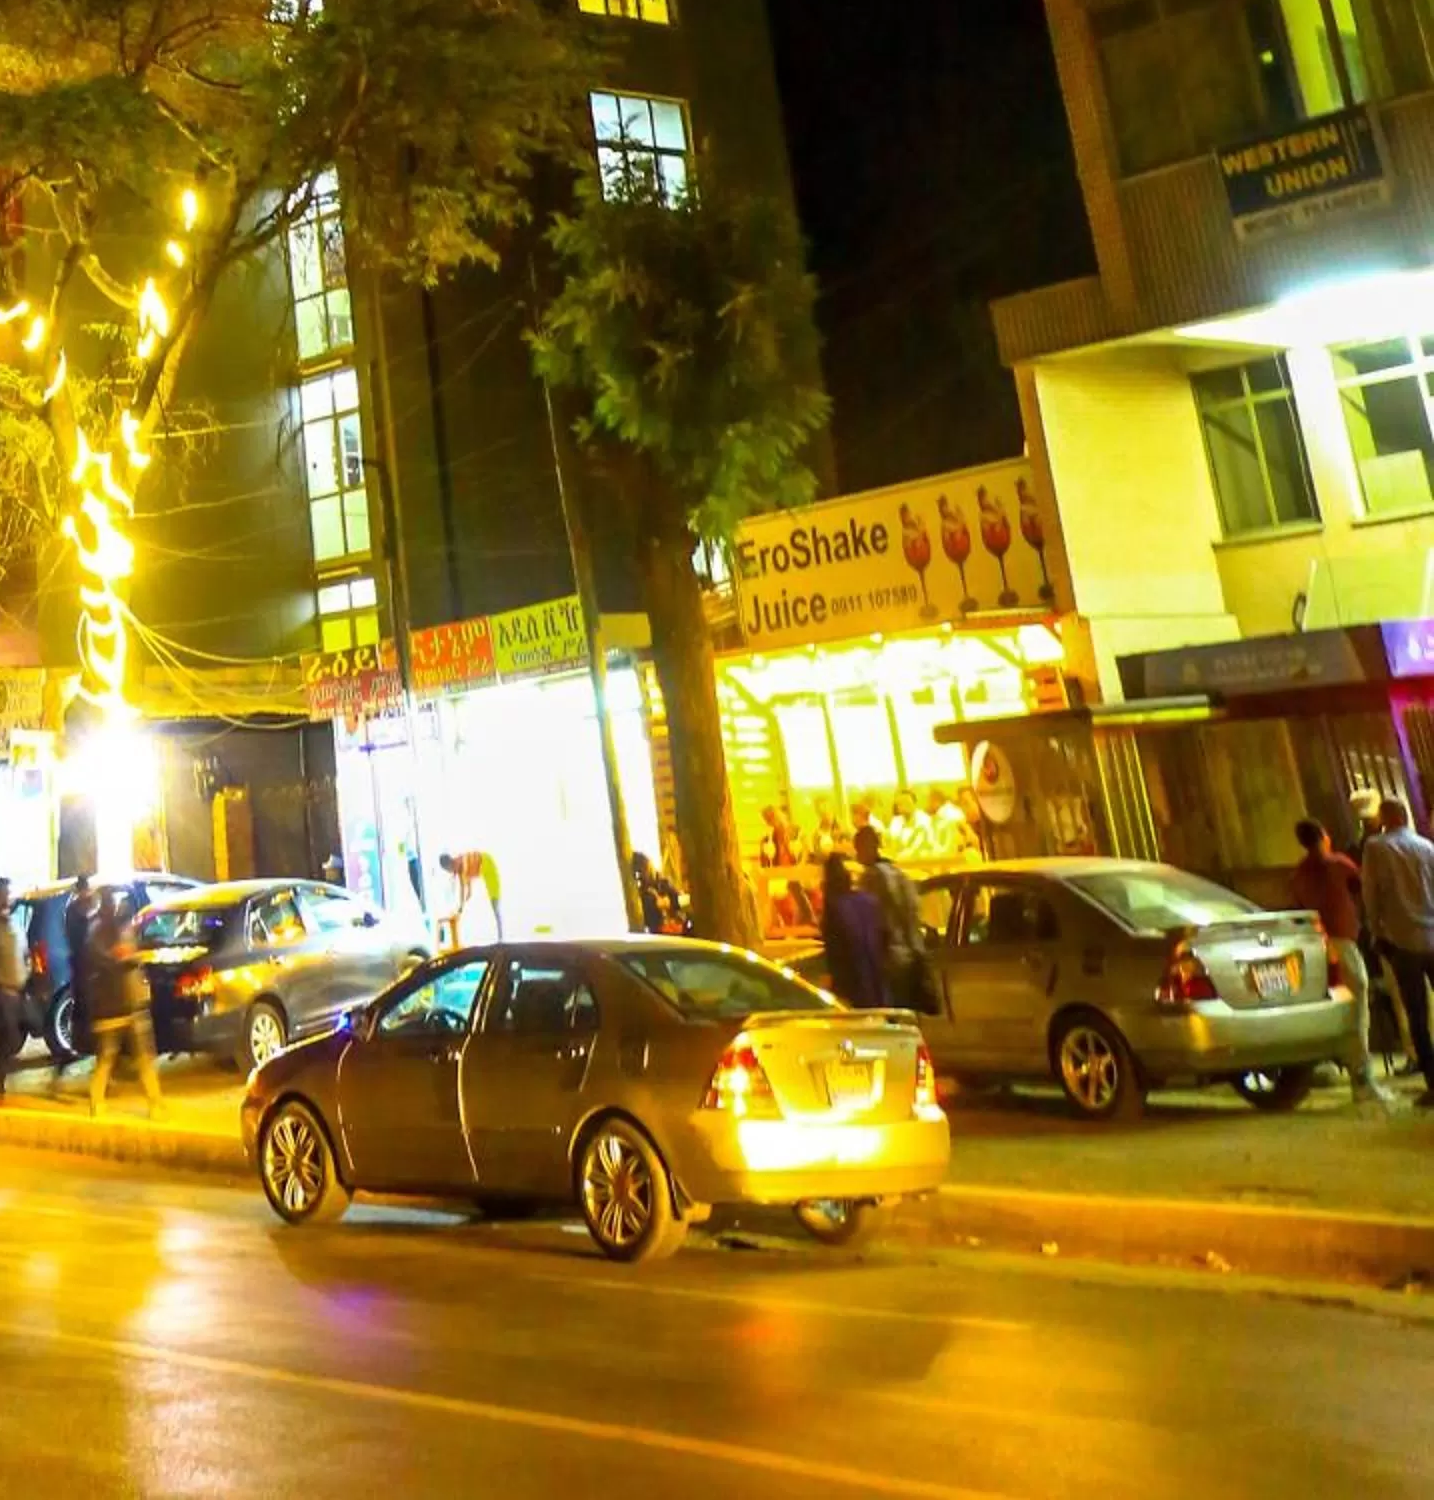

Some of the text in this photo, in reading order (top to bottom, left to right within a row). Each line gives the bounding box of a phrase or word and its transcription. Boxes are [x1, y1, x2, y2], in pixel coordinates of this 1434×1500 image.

[1221, 123, 1341, 177] WESTERN
[1265, 155, 1350, 198] UNION
[737, 517, 889, 581] EroShake
[747, 588, 827, 635] Juice
